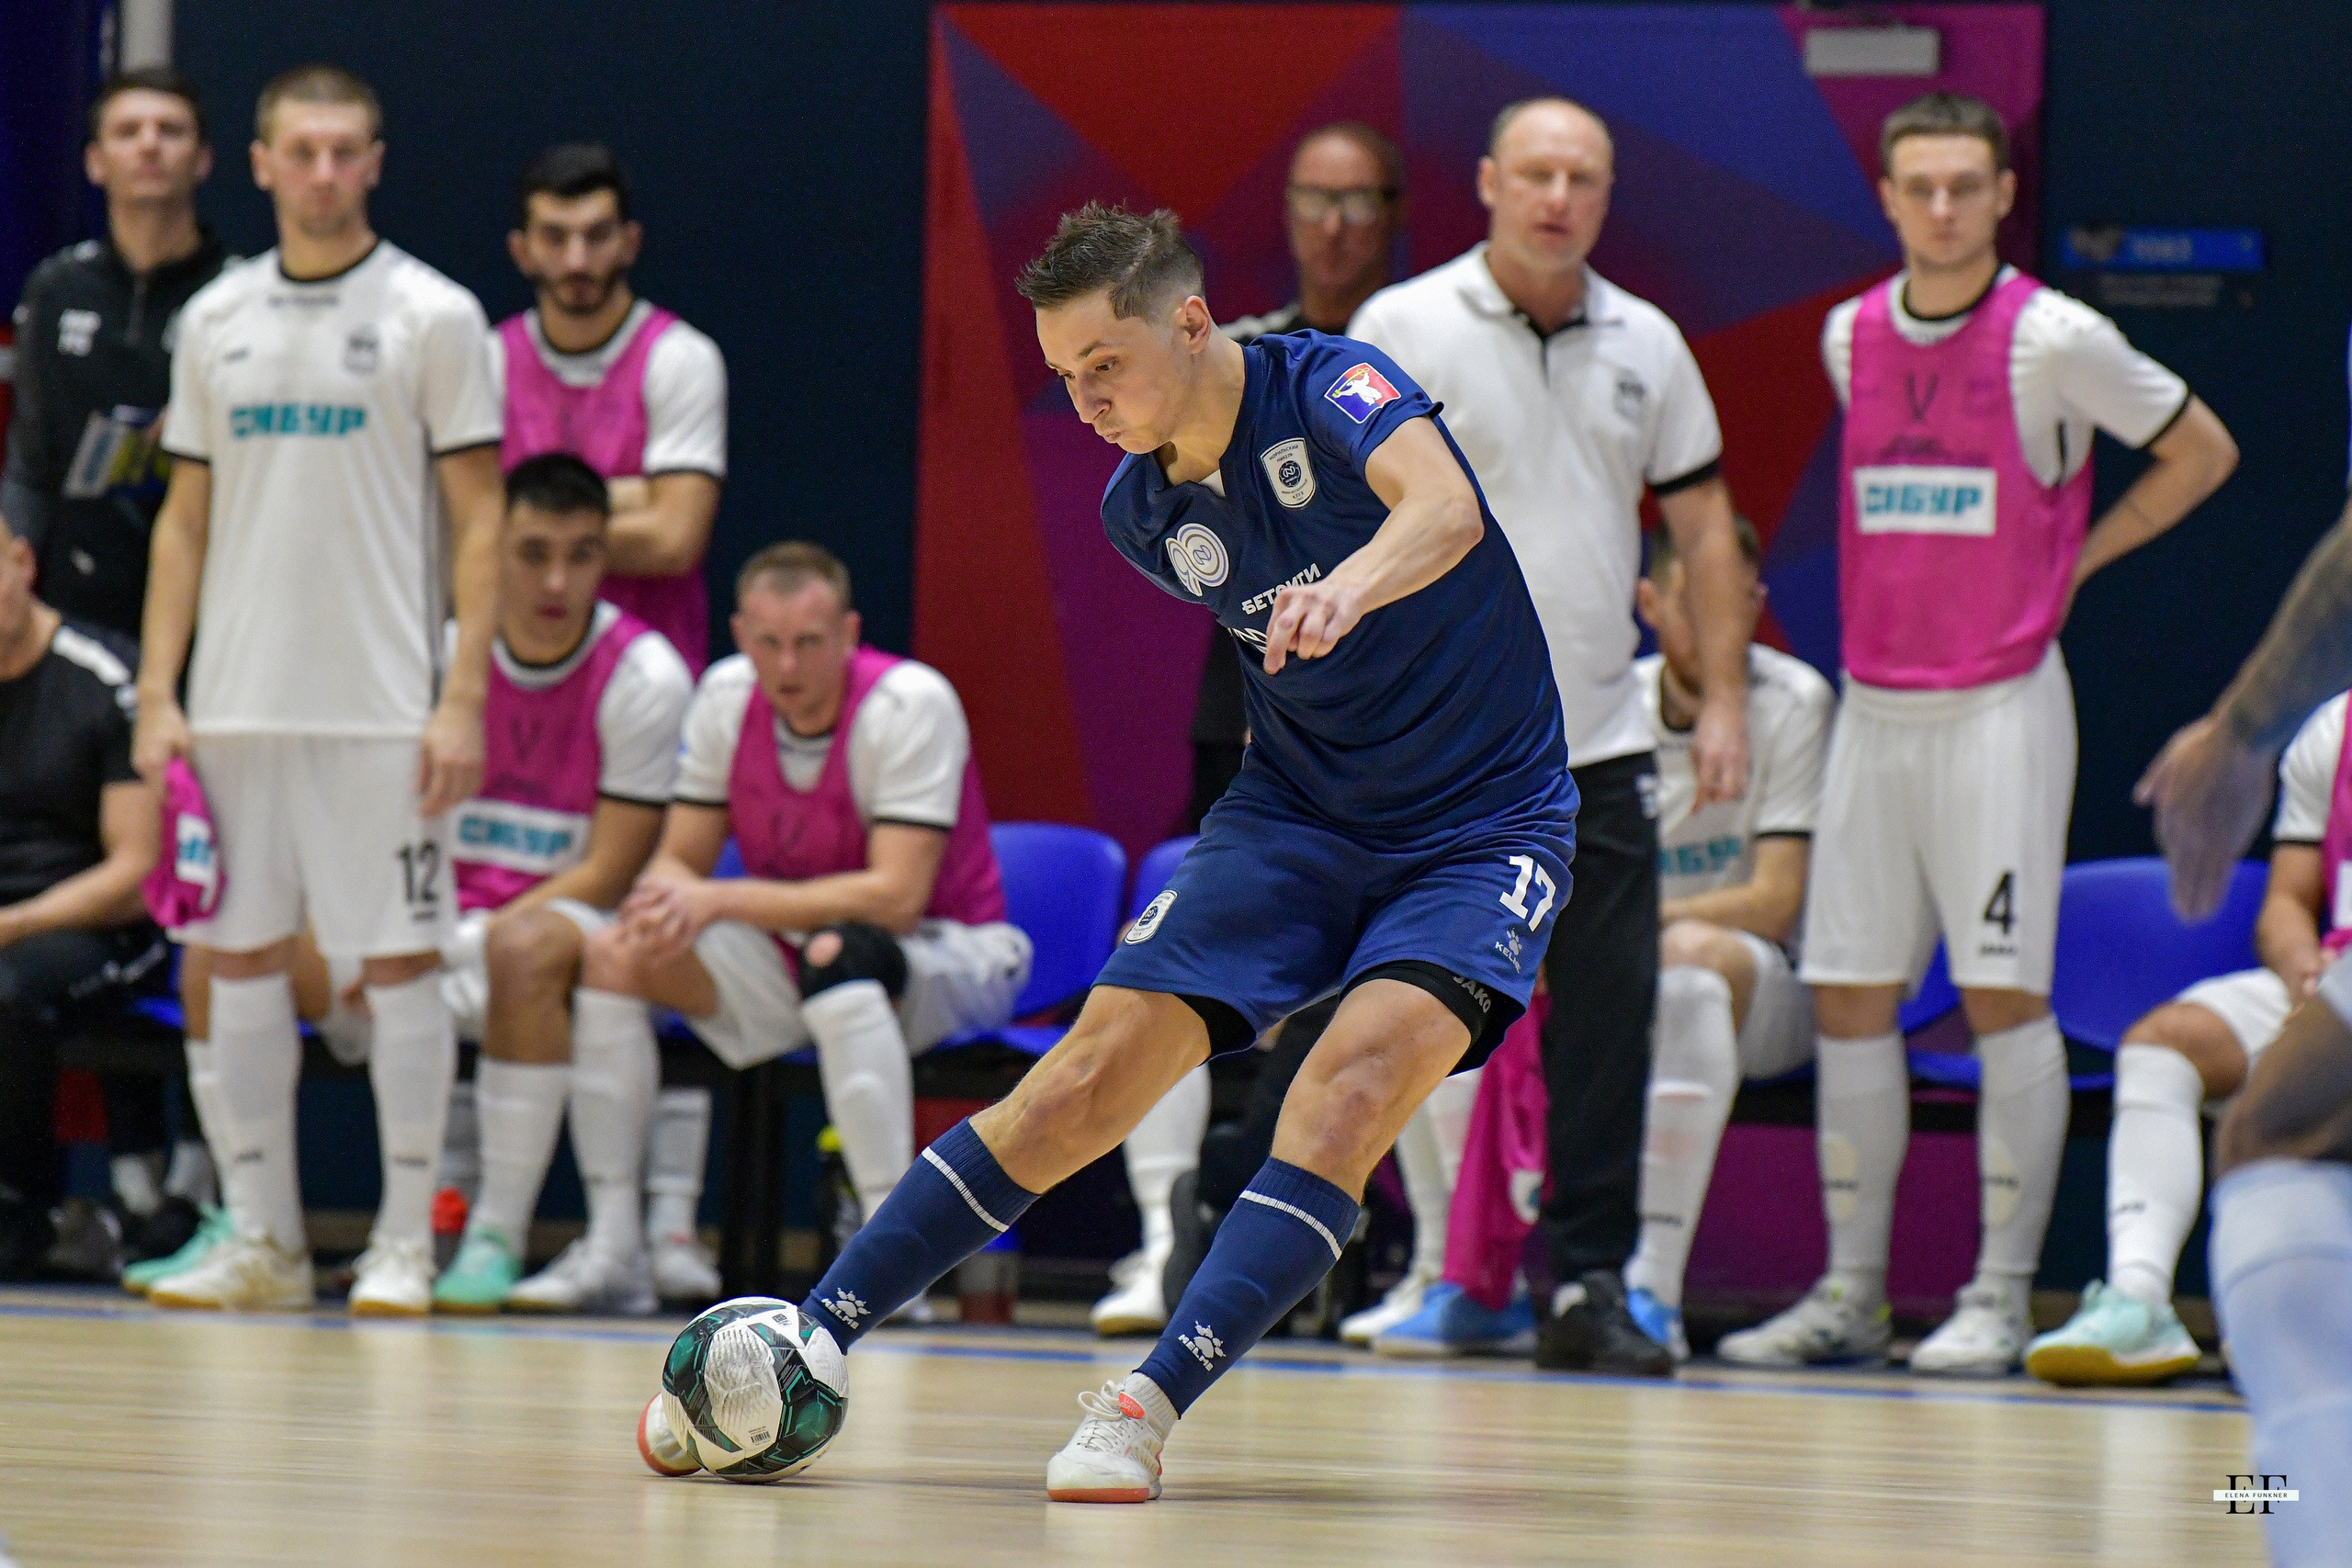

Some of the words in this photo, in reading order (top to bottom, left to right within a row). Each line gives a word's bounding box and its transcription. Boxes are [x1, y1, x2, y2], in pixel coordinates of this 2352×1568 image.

[398, 841, 440, 902] 12
[1498, 853, 1556, 932] 17
[1983, 870, 2016, 935] 4
[1495, 941, 1521, 974] KELME
[1453, 975, 1491, 1013] JAKO
[820, 1298, 860, 1330] KELME
[1178, 1334, 1214, 1371] KELME
